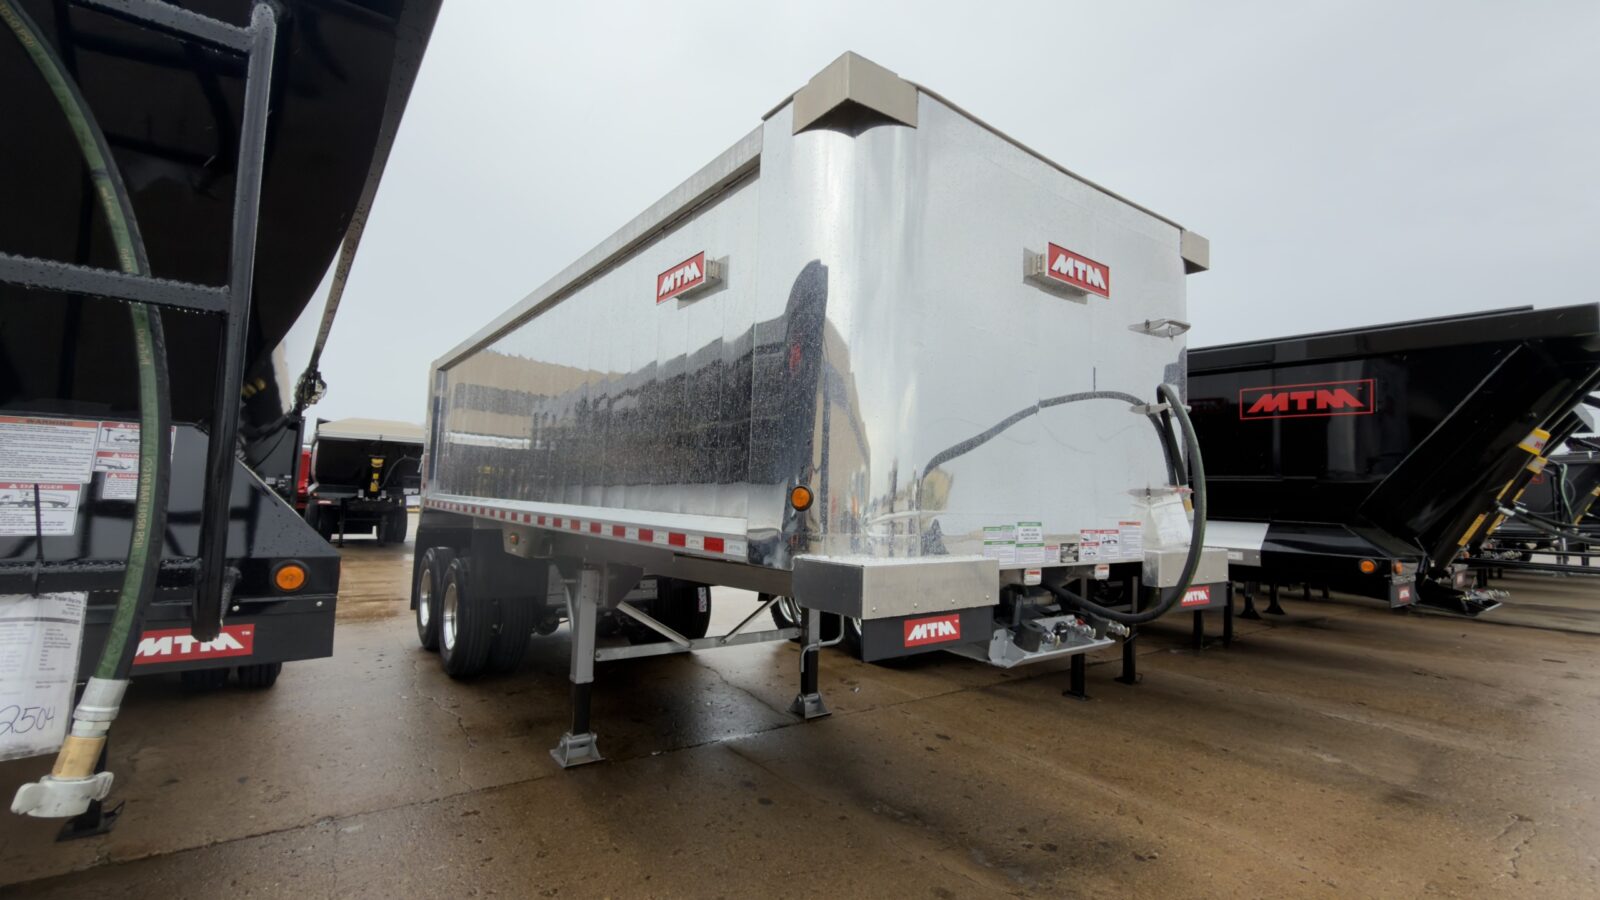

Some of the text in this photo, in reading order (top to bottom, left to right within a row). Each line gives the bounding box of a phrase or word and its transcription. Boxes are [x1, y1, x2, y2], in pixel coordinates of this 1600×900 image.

[658, 261, 702, 297] MTM
[1051, 253, 1107, 291] MTM
[1247, 388, 1365, 414] MTM
[1183, 590, 1208, 603] MTM
[907, 620, 957, 641] MTM
[135, 632, 244, 656] MTM
